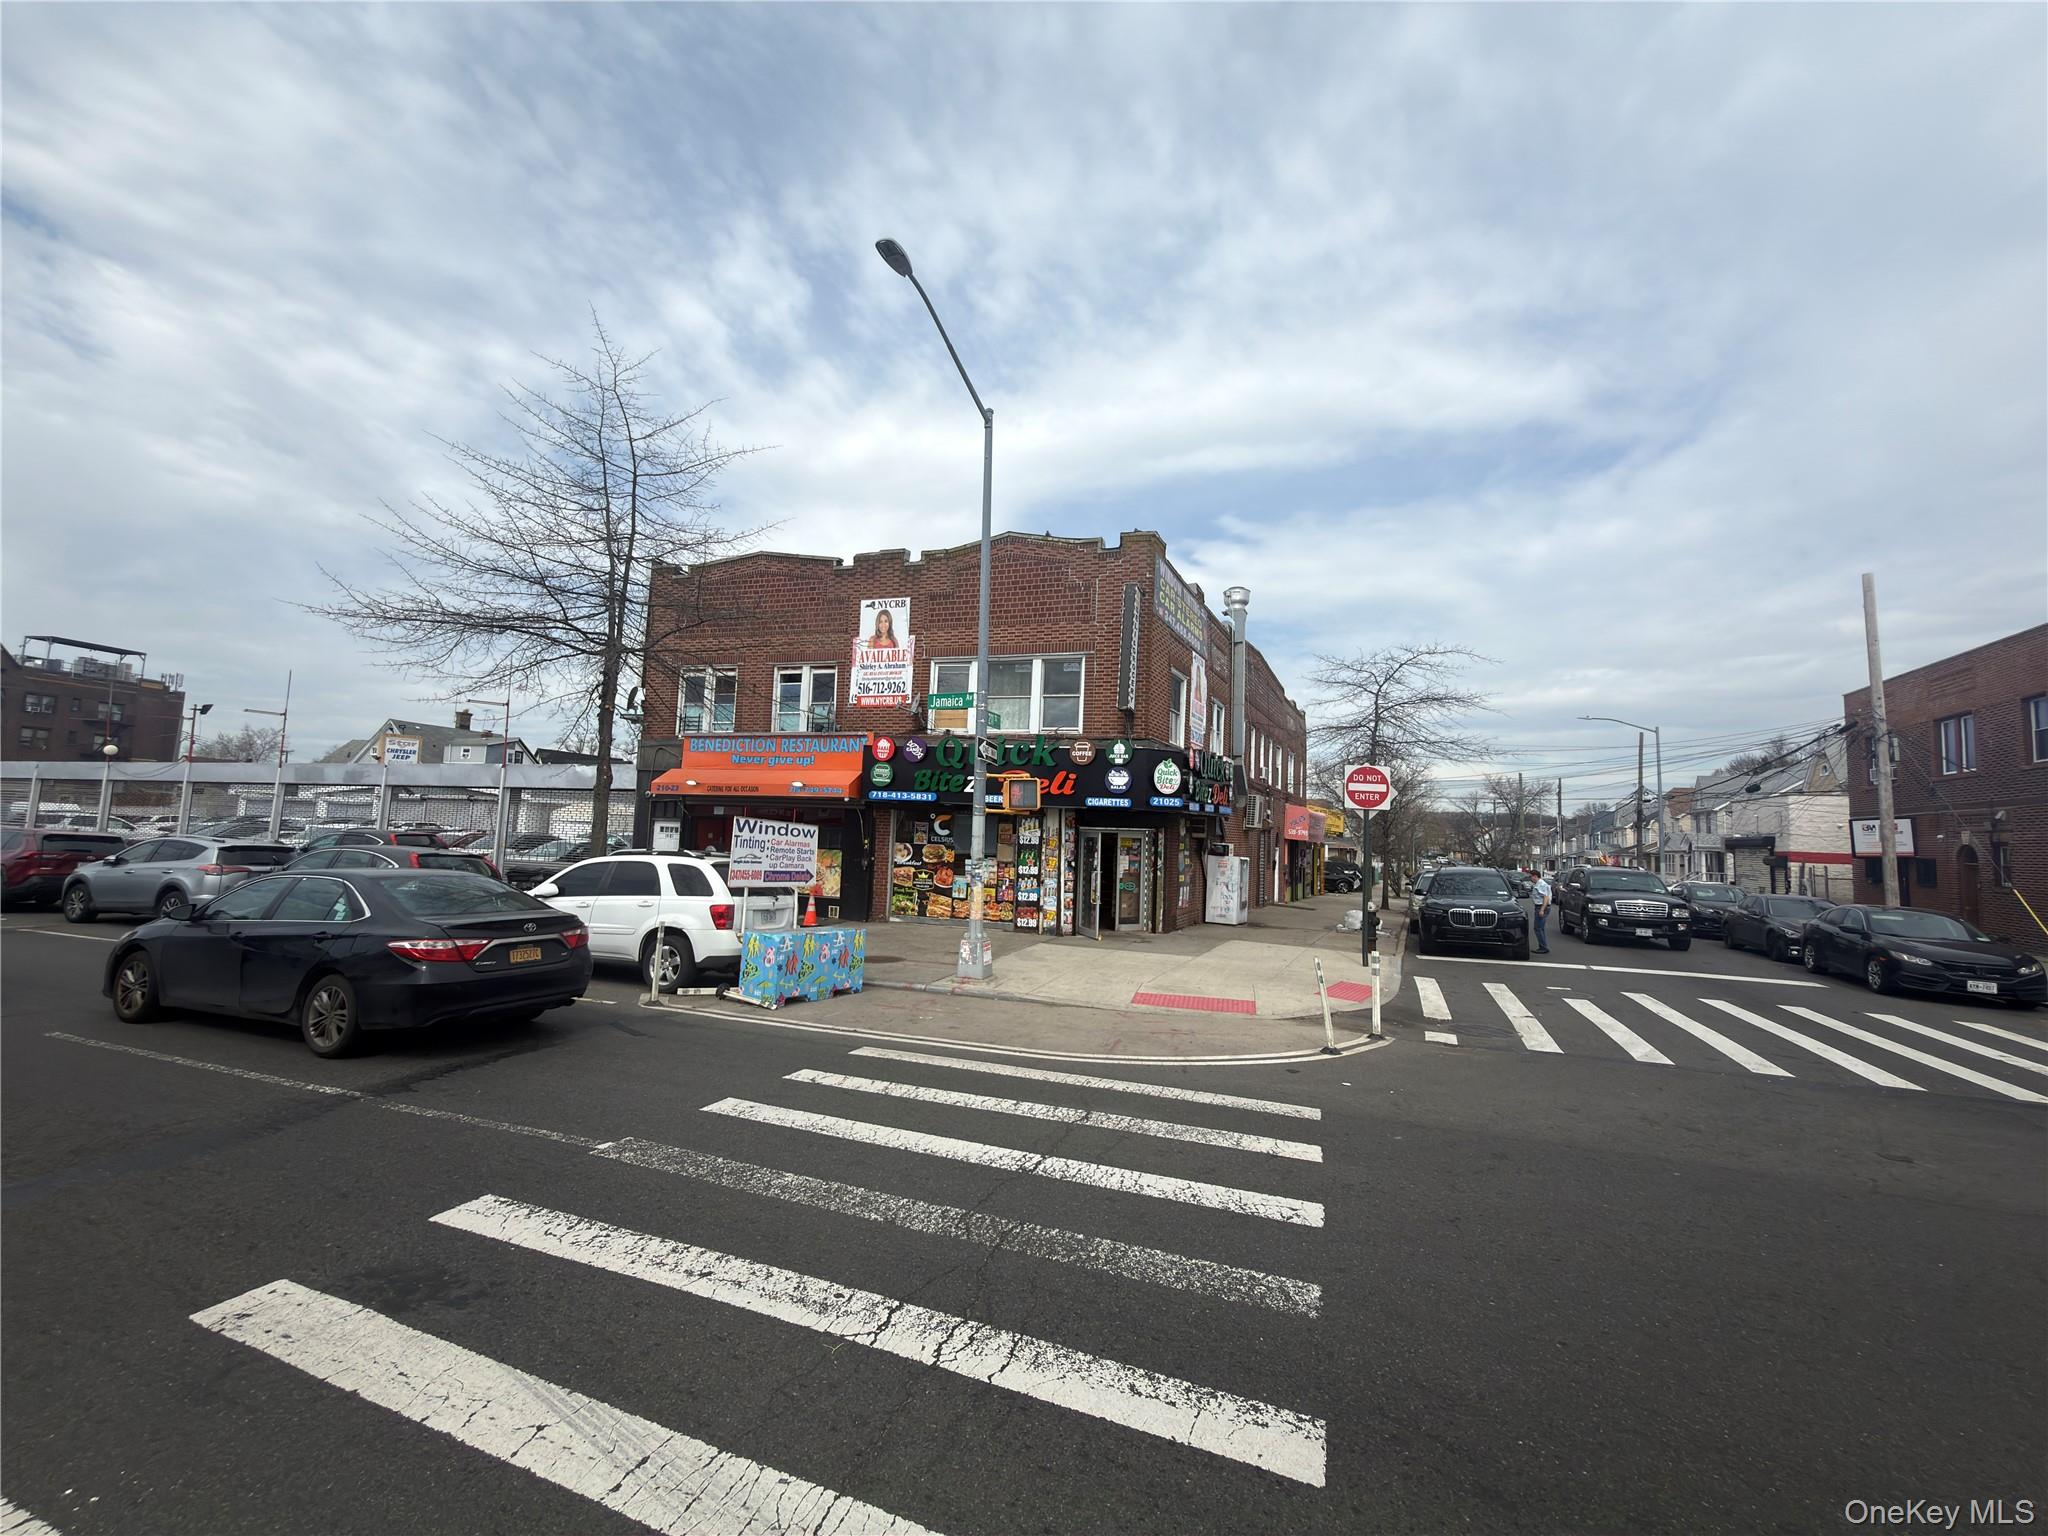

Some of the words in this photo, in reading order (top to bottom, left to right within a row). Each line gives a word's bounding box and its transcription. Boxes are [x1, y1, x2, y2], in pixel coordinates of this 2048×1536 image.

[877, 599, 907, 609] NYCRB
[860, 649, 907, 663] AVAILABLE
[860, 663, 877, 671] Shirley
[884, 662, 907, 670] Abraham
[857, 681, 907, 695] 516-712-9262
[930, 695, 963, 708] Jamaica
[690, 737, 776, 753] BENEDICTION
[781, 735, 868, 753] RESTAURANT
[731, 754, 765, 764] Never
[768, 754, 793, 766] give
[795, 754, 816, 766] up!
[1157, 768, 1178, 777] Quick
[1353, 773, 1364, 782] DO
[1366, 774, 1382, 782] NOT
[872, 791, 932, 801] 718-413-5831
[1354, 792, 1380, 801] ENTER
[1087, 797, 1129, 807] CIGARETTES
[1153, 797, 1180, 806] 21025
[735, 818, 816, 839] Window
[734, 835, 766, 853] Tinting
[770, 838, 783, 847] Car
[784, 839, 811, 848] Alarmas
[930, 835, 954, 843] CELSIUS
[770, 845, 795, 854] Remote
[796, 846, 815, 855] Starts
[769, 853, 795, 863] CarPlay
[797, 854, 812, 862] Back
[768, 862, 778, 870] up
[779, 861, 805, 869] Camara
